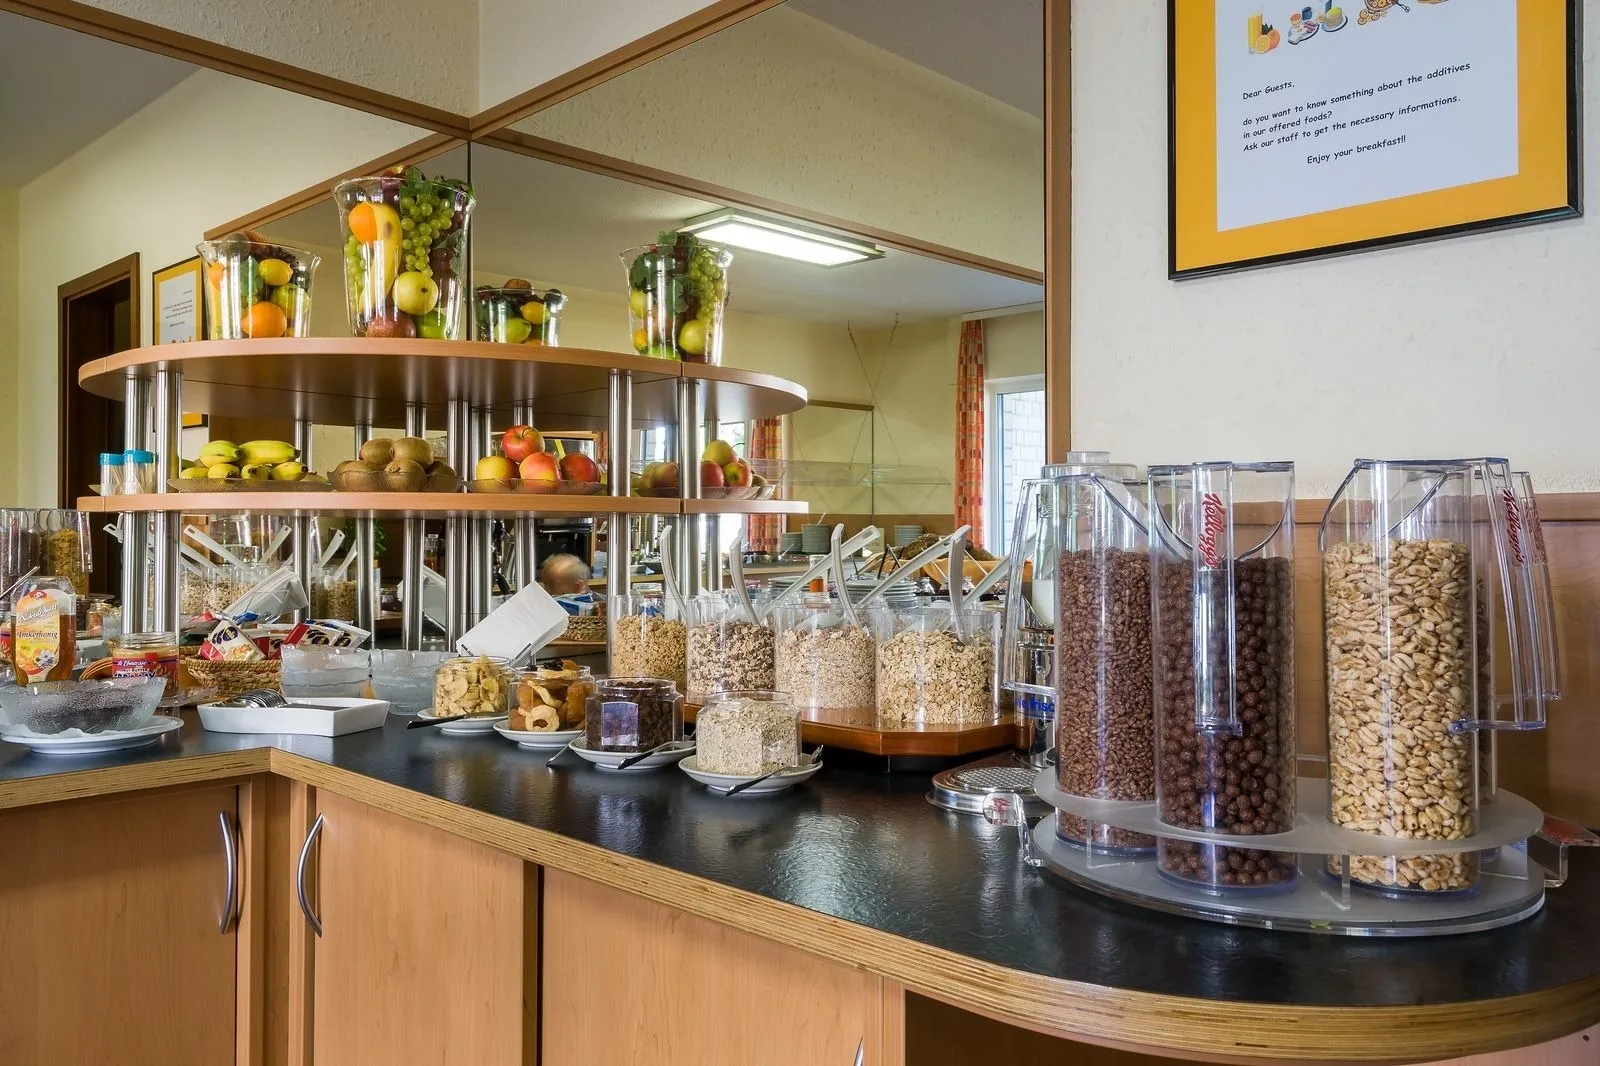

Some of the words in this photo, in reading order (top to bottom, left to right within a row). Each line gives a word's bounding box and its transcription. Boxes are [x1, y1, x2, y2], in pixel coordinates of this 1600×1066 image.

[1242, 90, 1262, 100] Dear
[1265, 81, 1295, 94] Guests,
[1242, 118, 1253, 126] do
[1255, 115, 1269, 124] you
[1272, 108, 1291, 118] want
[1306, 102, 1327, 110] know
[1330, 87, 1374, 104] something
[1377, 80, 1403, 92] about
[1407, 75, 1423, 84] the
[1426, 63, 1471, 80] additives
[1243, 142, 1258, 151] Ask
[1260, 139, 1274, 148] our
[1277, 132, 1299, 144] staff
[1314, 126, 1329, 137] get
[1332, 122, 1347, 131] the
[1350, 111, 1395, 127] necessary
[1398, 95, 1461, 115] informations.
[1253, 128, 1266, 137] our
[1269, 118, 1301, 133] offered
[1304, 110, 1333, 124] foods?
[1307, 153, 1331, 164] Enjoy
[1333, 148, 1354, 160] your
[1356, 135, 1406, 153] breakfast!!
[1198, 493, 1226, 568] Kellogg's
[1503, 489, 1525, 564] Kellogg's
